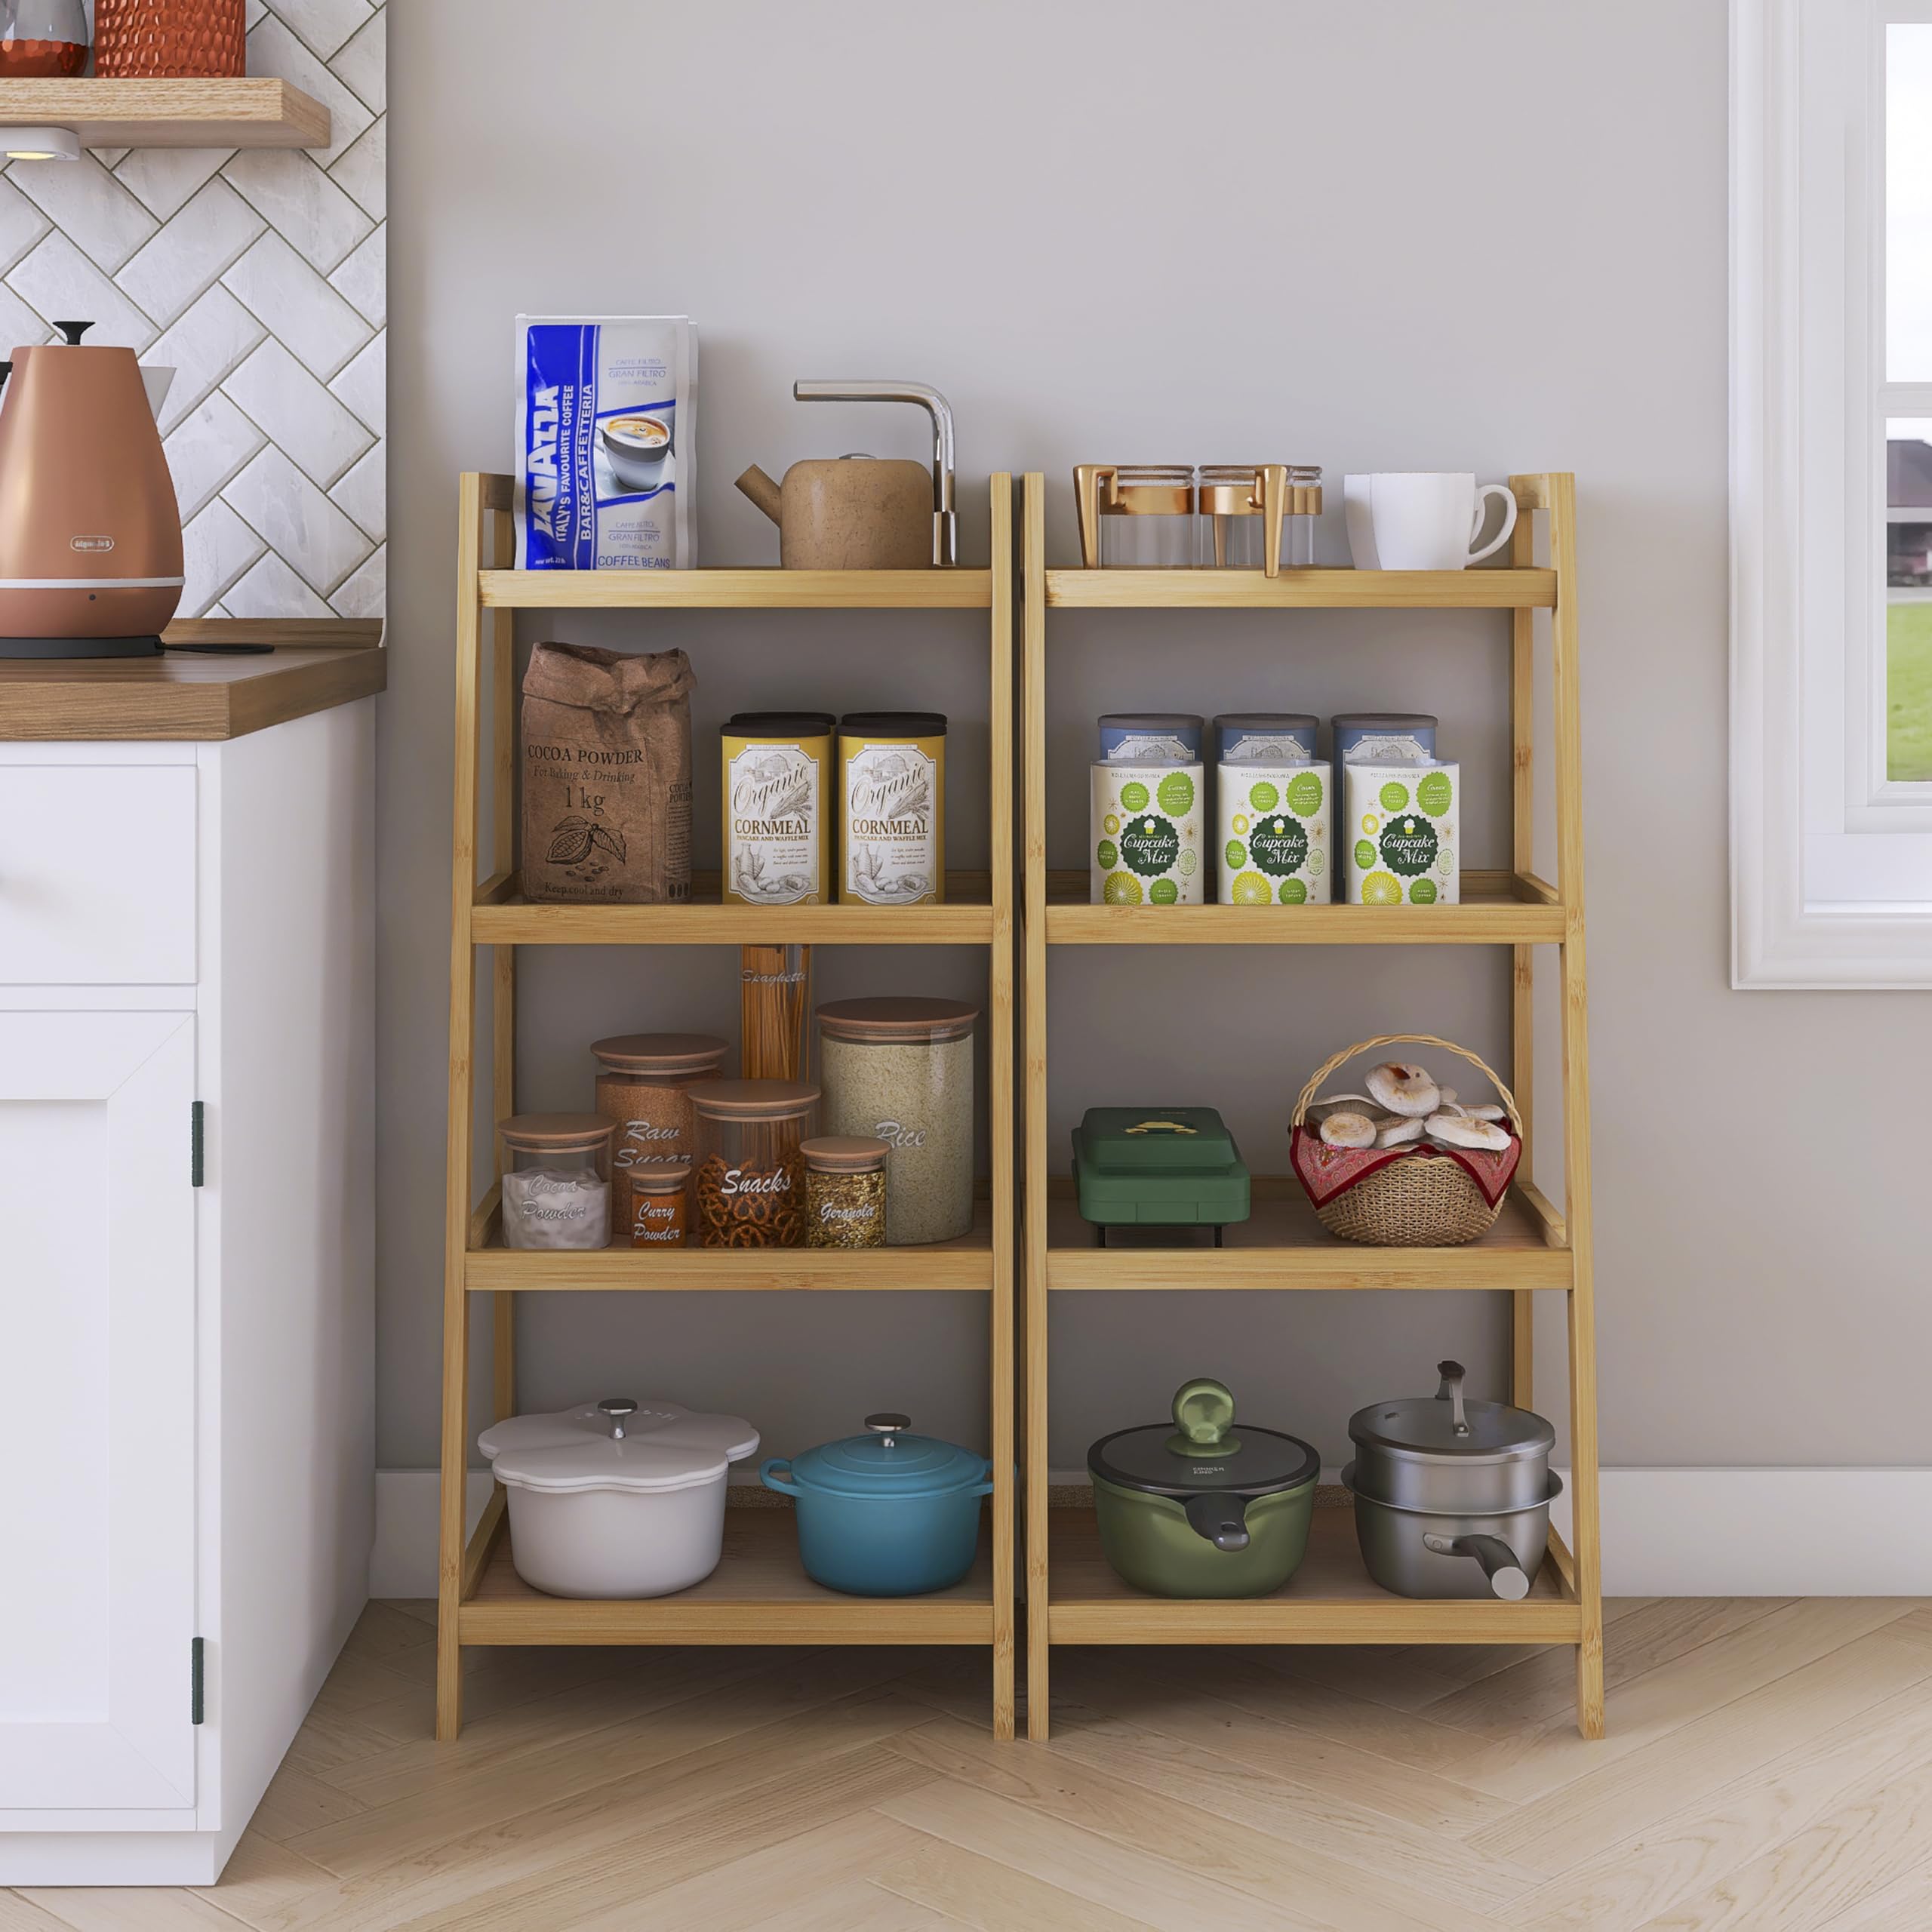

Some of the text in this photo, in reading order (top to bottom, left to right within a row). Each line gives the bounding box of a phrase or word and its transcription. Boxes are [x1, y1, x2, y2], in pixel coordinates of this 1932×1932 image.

[637, 370, 666, 378] FILTRO
[528, 385, 558, 539] LAVAZZA
[555, 385, 574, 542] ITALY'S FAVOURITE COFFEE
[579, 384, 592, 540] BAR&CAFFETTERIA
[608, 533, 660, 542] GRAN FILTRO
[598, 555, 670, 568] COFFEE BEANS
[528, 744, 644, 765] COCOA POWDER
[533, 765, 635, 784] For Baking & Drinking
[734, 762, 807, 817] Organic
[851, 762, 924, 817] Organic
[566, 785, 606, 816] 1 kg
[735, 819, 811, 835] CORNMEAL
[852, 819, 929, 835] CORNMEAL
[1124, 833, 1176, 851] Cupcake
[1253, 833, 1305, 851] Cupcake
[1383, 833, 1435, 851] Cupcake
[1137, 848, 1171, 865] Mix
[1266, 848, 1300, 865] Mix
[1398, 848, 1429, 865] Mix
[545, 881, 567, 897] Keep
[590, 886, 605, 895] and
[609, 885, 623, 900] dry
[624, 1120, 680, 1142] Raw
[875, 1121, 926, 1149] Rice
[529, 1174, 577, 1197] Cocoa
[721, 1167, 792, 1194] Snacks
[521, 1200, 586, 1220] Powder
[638, 1201, 675, 1222] Curry
[634, 1223, 680, 1241] Powder
